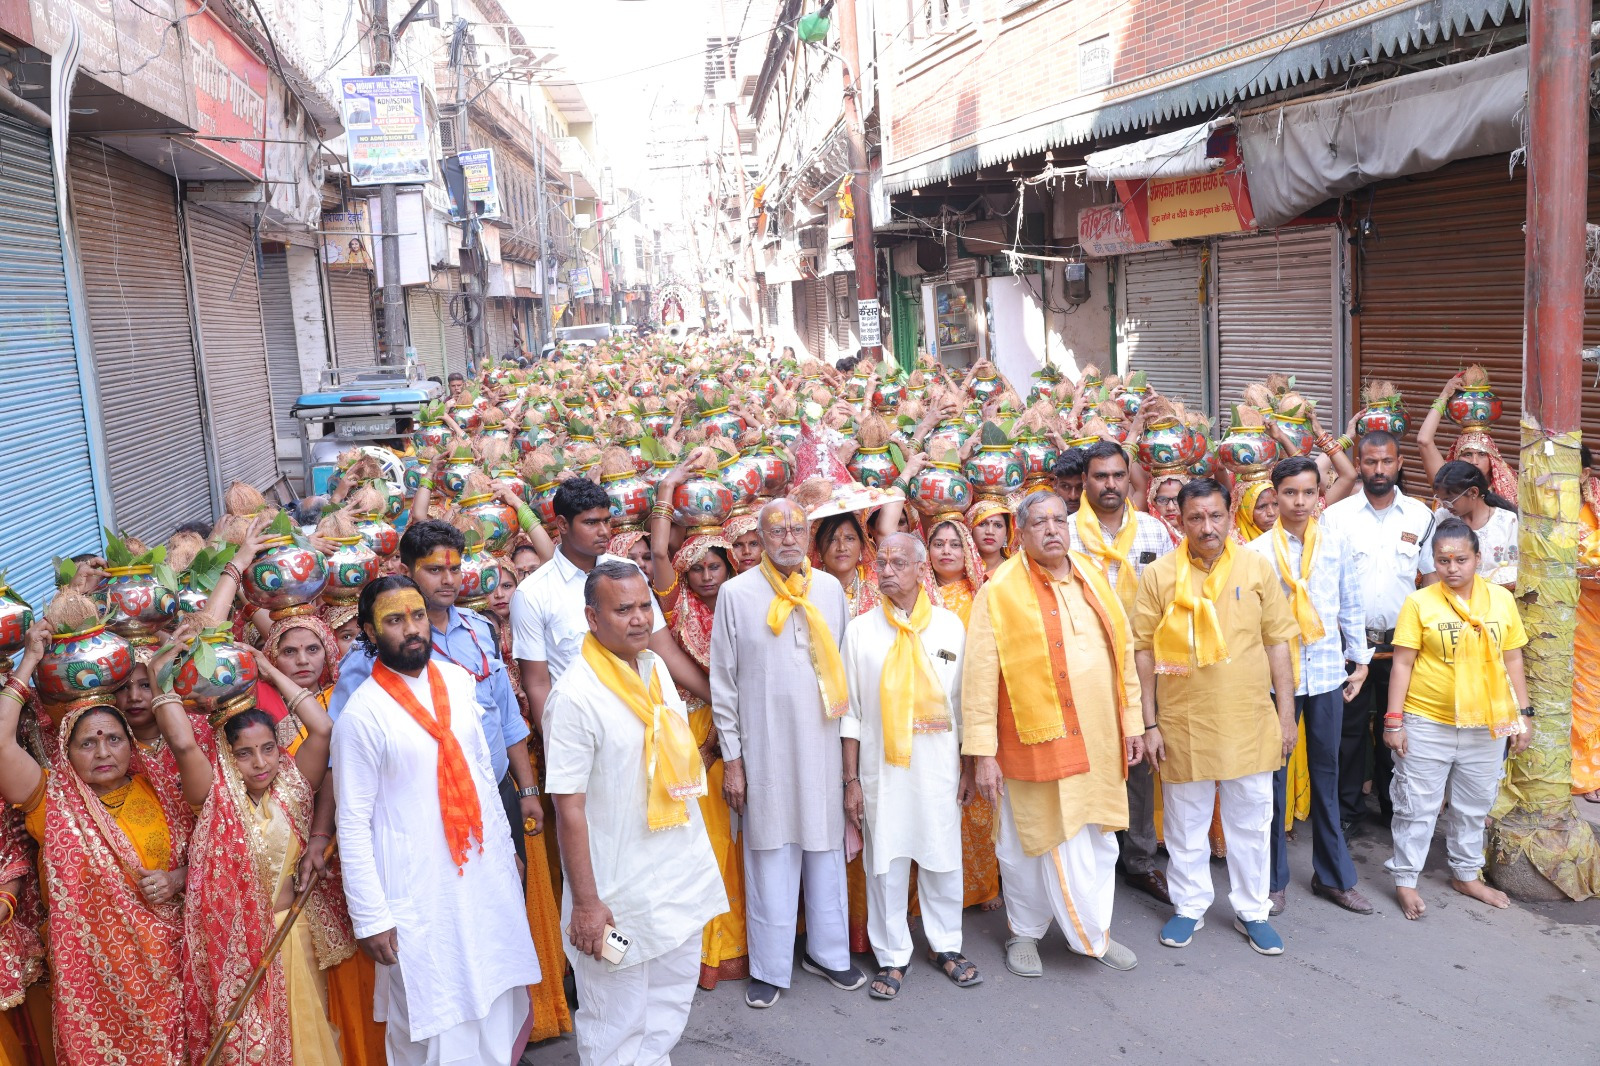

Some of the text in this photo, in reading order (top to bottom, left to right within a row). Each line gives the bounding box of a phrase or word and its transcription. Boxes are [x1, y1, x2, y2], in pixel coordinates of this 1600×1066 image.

[390, 81, 414, 89] ACADEMY
[1175, 179, 1188, 196] मदन
[1189, 176, 1202, 193] लाल
[1188, 208, 1195, 217] के
[1214, 204, 1221, 213] के
[859, 305, 878, 316] कैंसर
